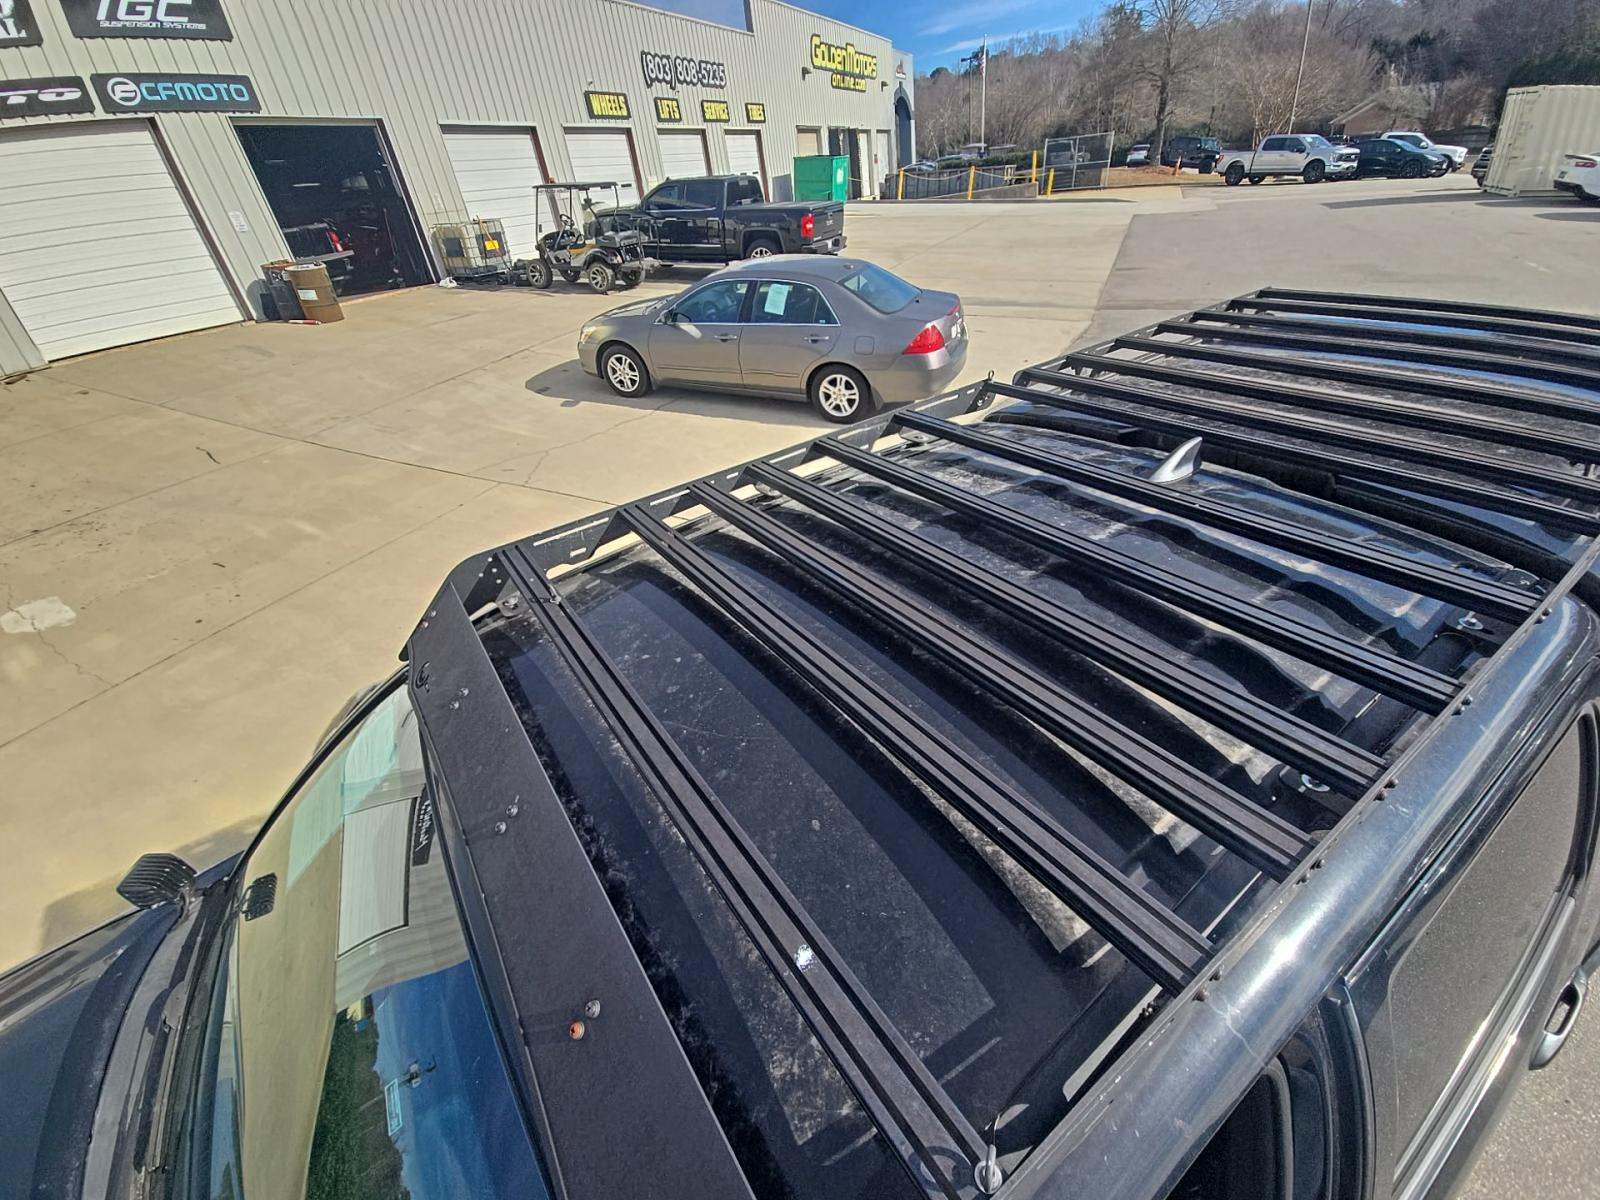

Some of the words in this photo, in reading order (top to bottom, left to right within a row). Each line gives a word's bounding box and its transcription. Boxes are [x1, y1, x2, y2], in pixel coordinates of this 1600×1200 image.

[99, 20, 160, 28] SUSPENSION
[162, 22, 206, 30] SYSTEMS
[641, 52, 675, 88] (803)
[675, 57, 726, 87] 808-5235
[140, 82, 250, 101] CFMOTO
[589, 93, 628, 116] WHEELS
[657, 99, 679, 120] LIFTS
[703, 102, 729, 120] SERVICE
